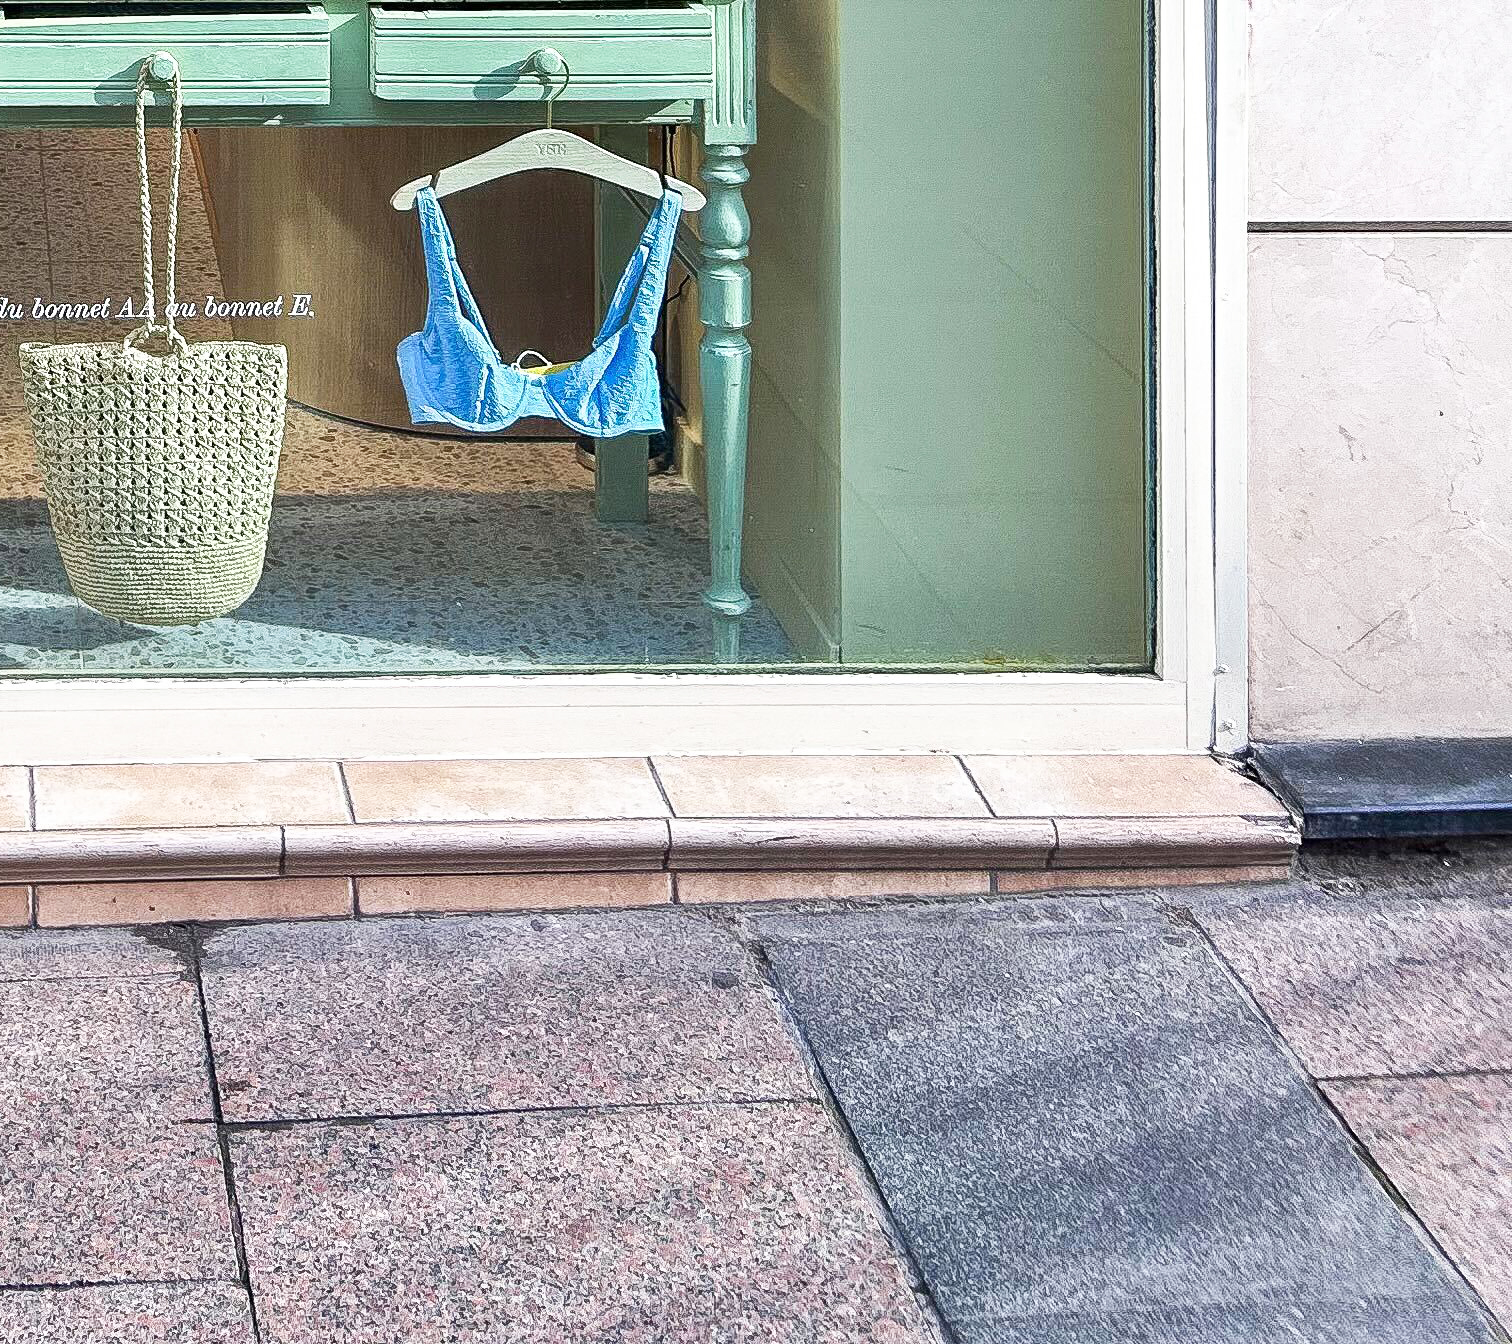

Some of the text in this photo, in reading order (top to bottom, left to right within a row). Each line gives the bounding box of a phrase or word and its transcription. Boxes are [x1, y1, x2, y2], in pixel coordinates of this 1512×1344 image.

[31, 296, 111, 320] bonnet
[165, 301, 197, 319] au
[203, 295, 284, 318] bonnet
[287, 293, 316, 319] E.
